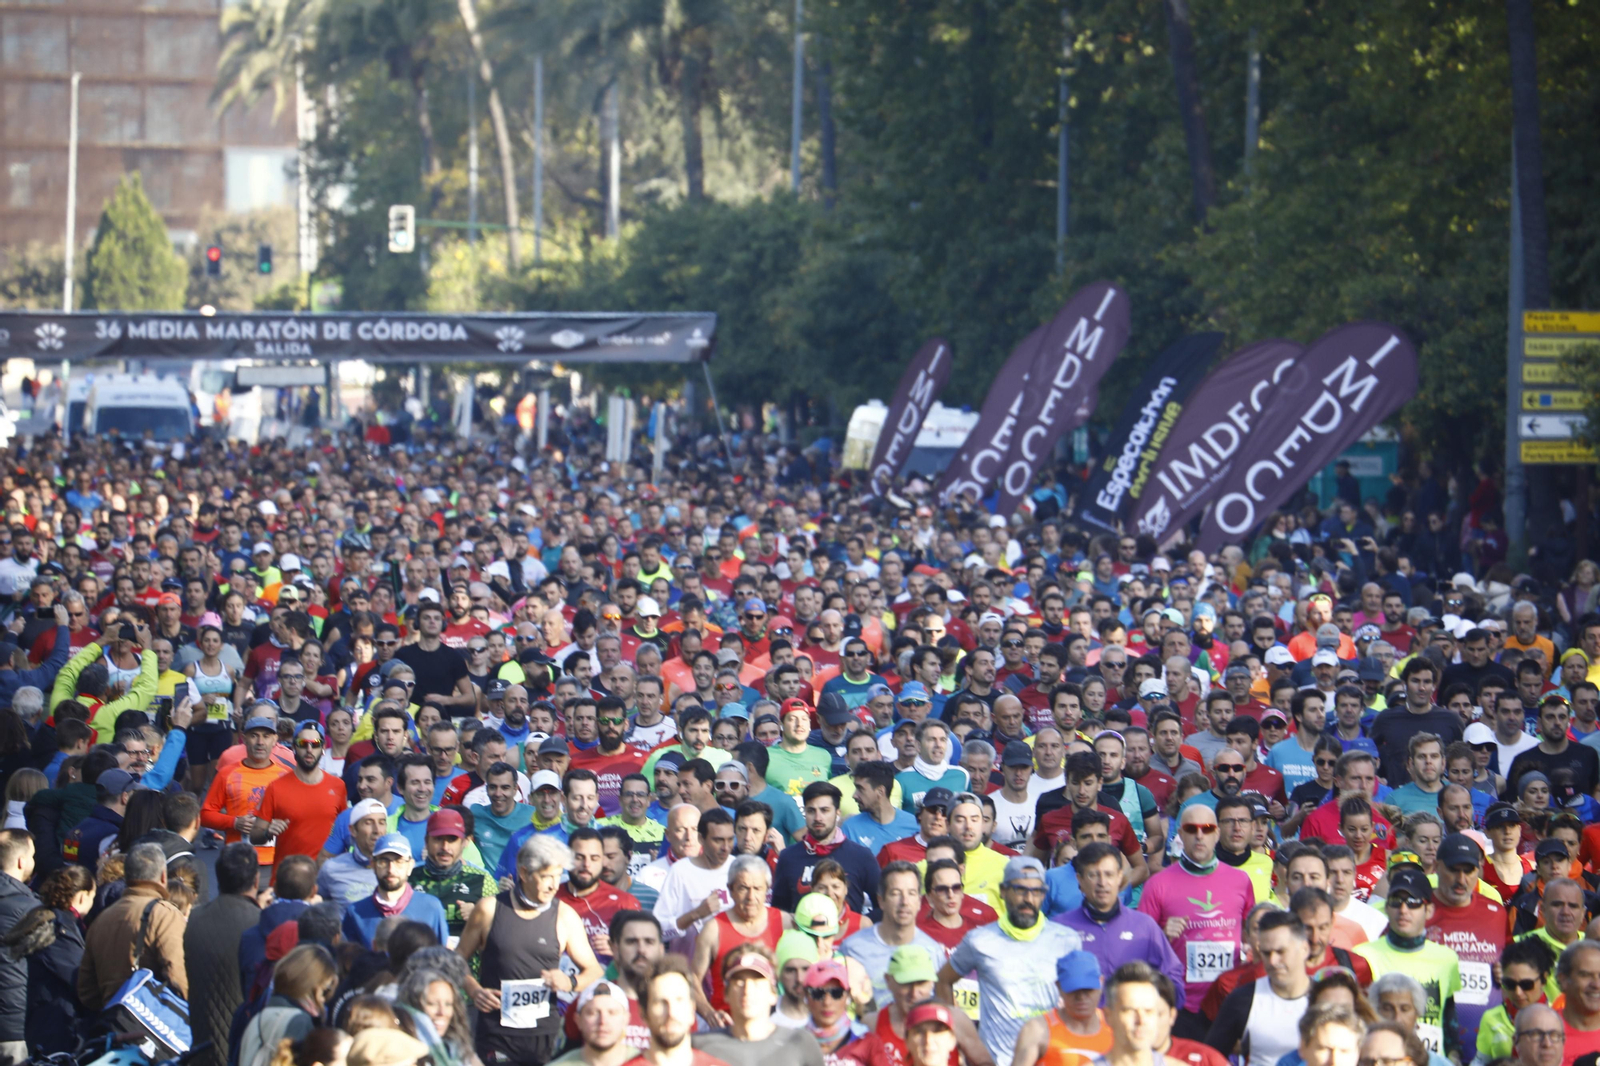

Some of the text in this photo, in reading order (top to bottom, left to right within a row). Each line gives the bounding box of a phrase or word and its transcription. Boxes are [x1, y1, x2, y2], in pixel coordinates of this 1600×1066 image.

[95, 318, 468, 341] 36 MEDIA MARATÓN DE CÓRDOBA
[255, 341, 312, 356] SALIDA
[1004, 287, 1116, 496] IMDECO
[1215, 334, 1400, 535] IMDECO
[1443, 931, 1478, 944] MEDIA
[1197, 953, 1232, 968] 3217
[512, 989, 547, 1007] 2987
